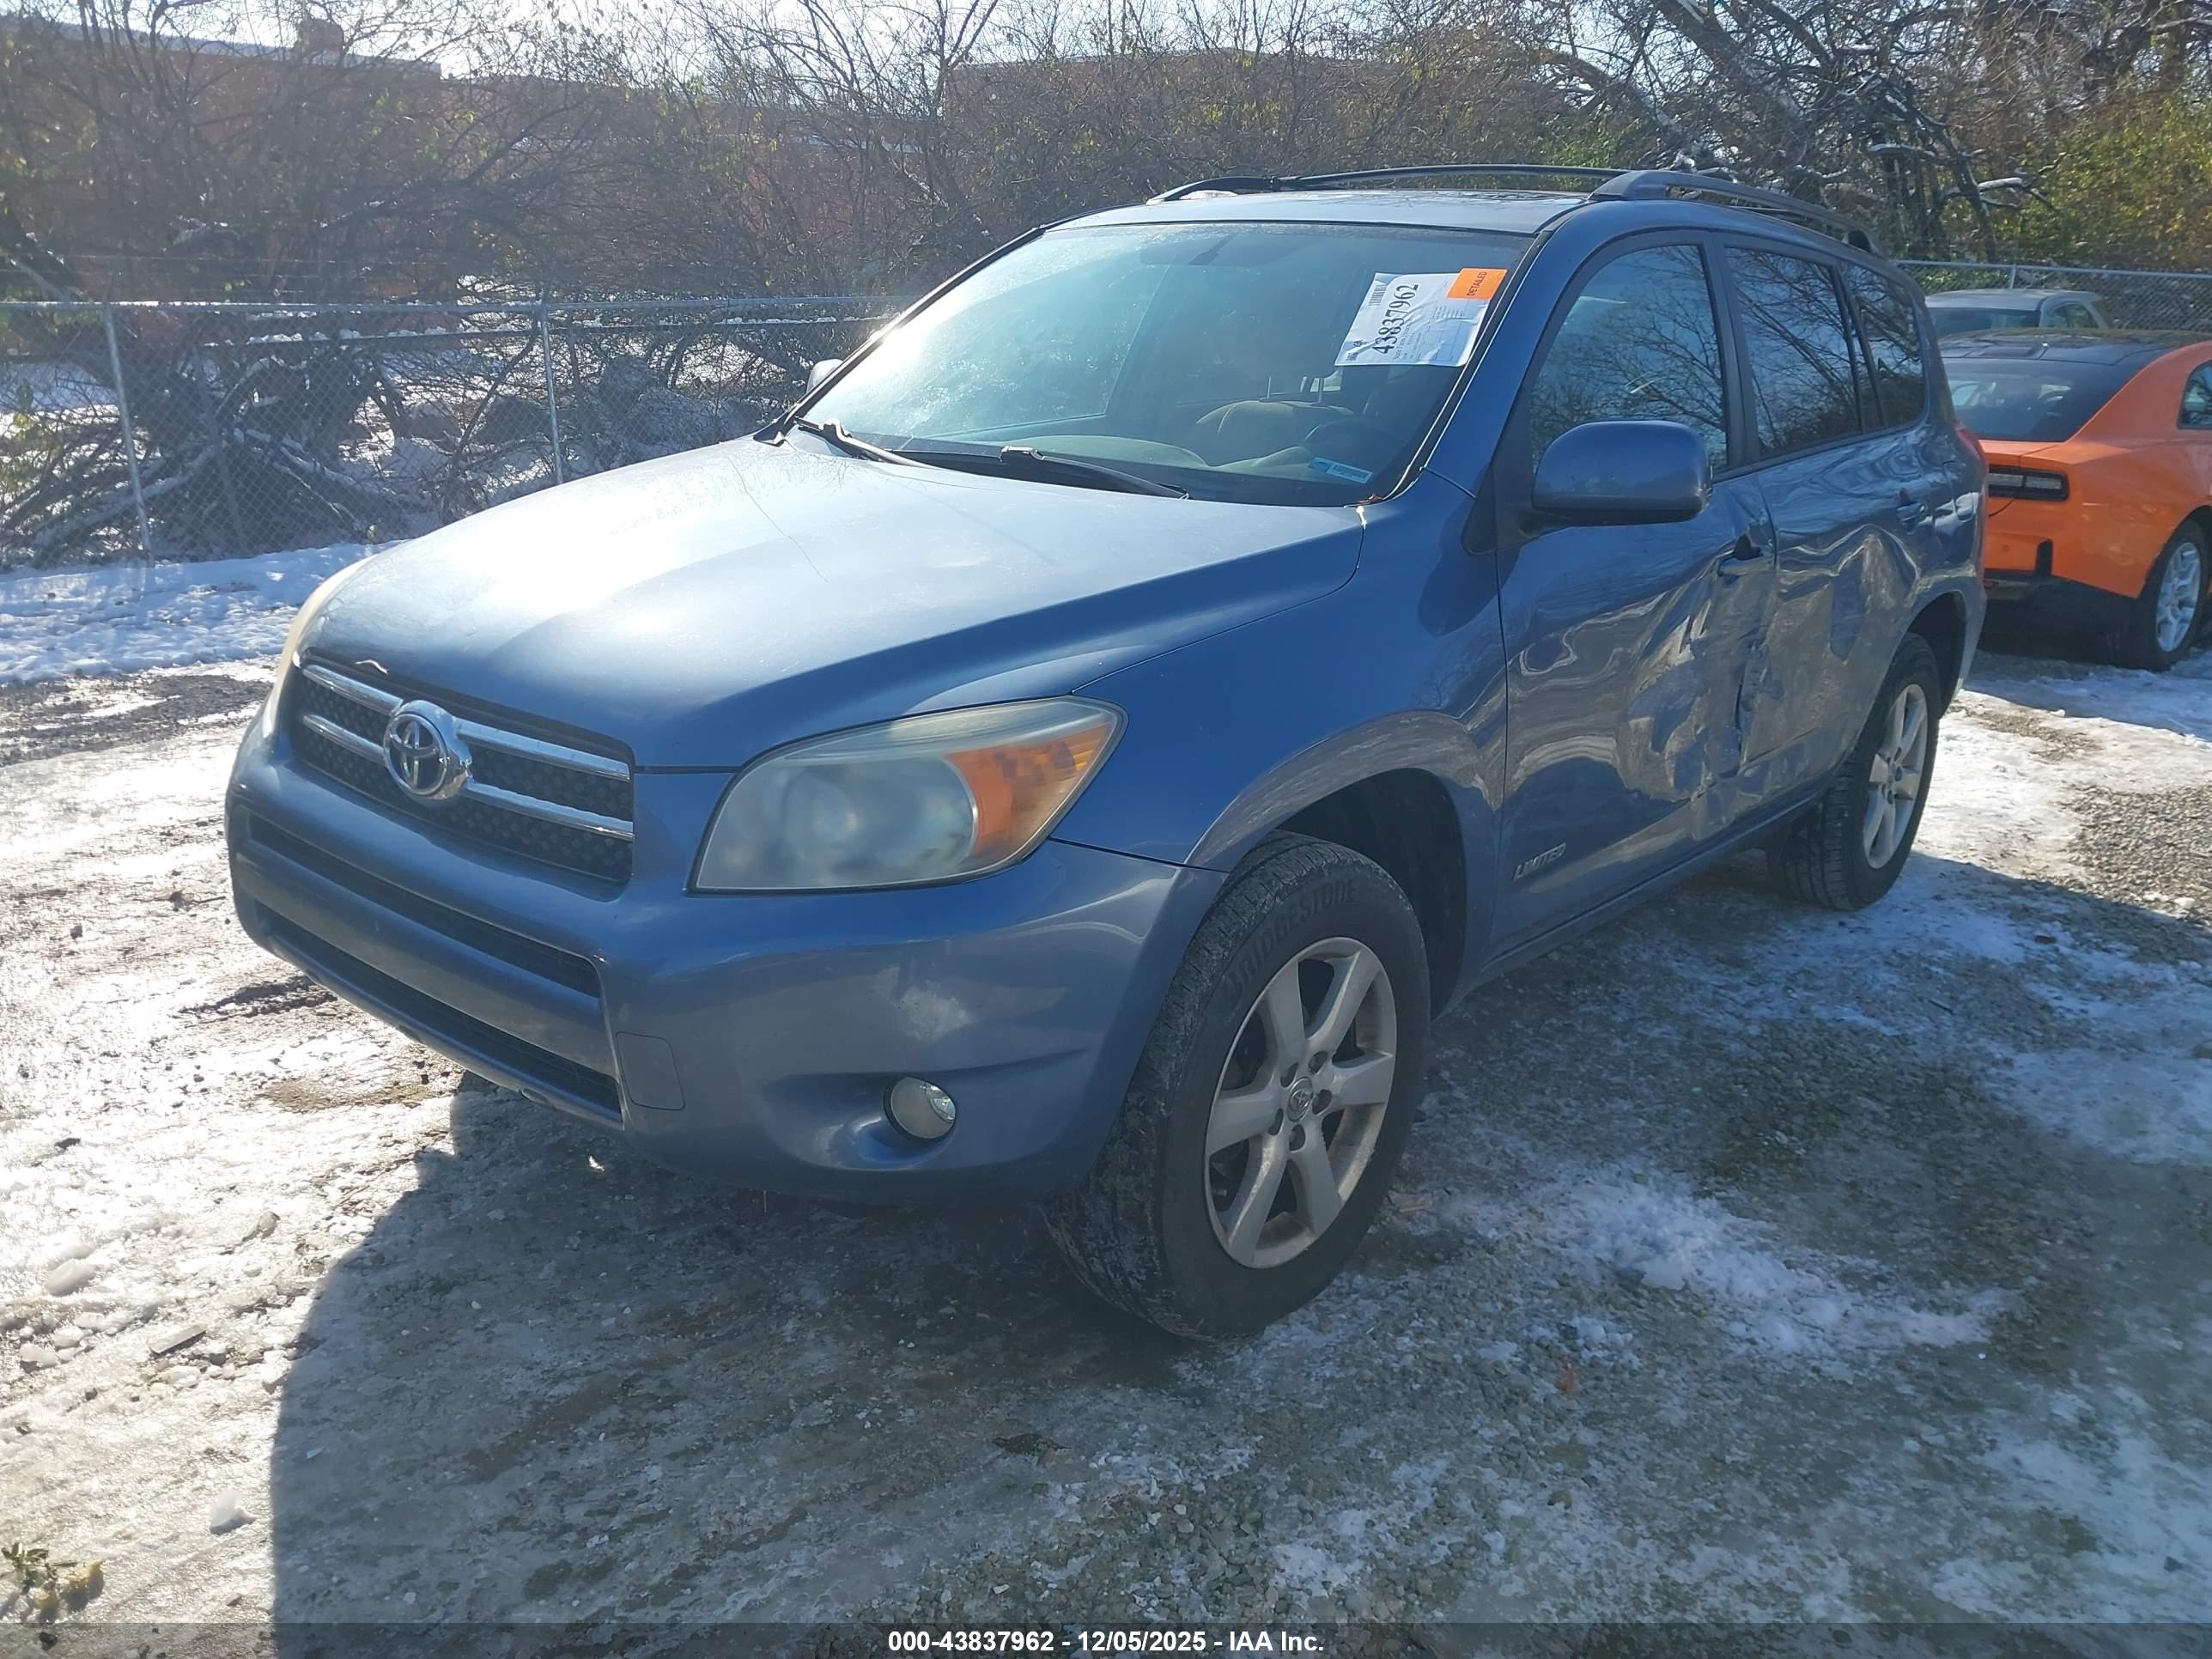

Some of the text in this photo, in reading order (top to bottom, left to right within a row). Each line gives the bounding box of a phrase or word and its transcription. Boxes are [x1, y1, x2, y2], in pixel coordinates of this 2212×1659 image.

[1371, 283, 1420, 354] 43837962
[1466, 270, 1488, 296] DETAILED
[1225, 878, 1358, 1003] BRIDGESTONE
